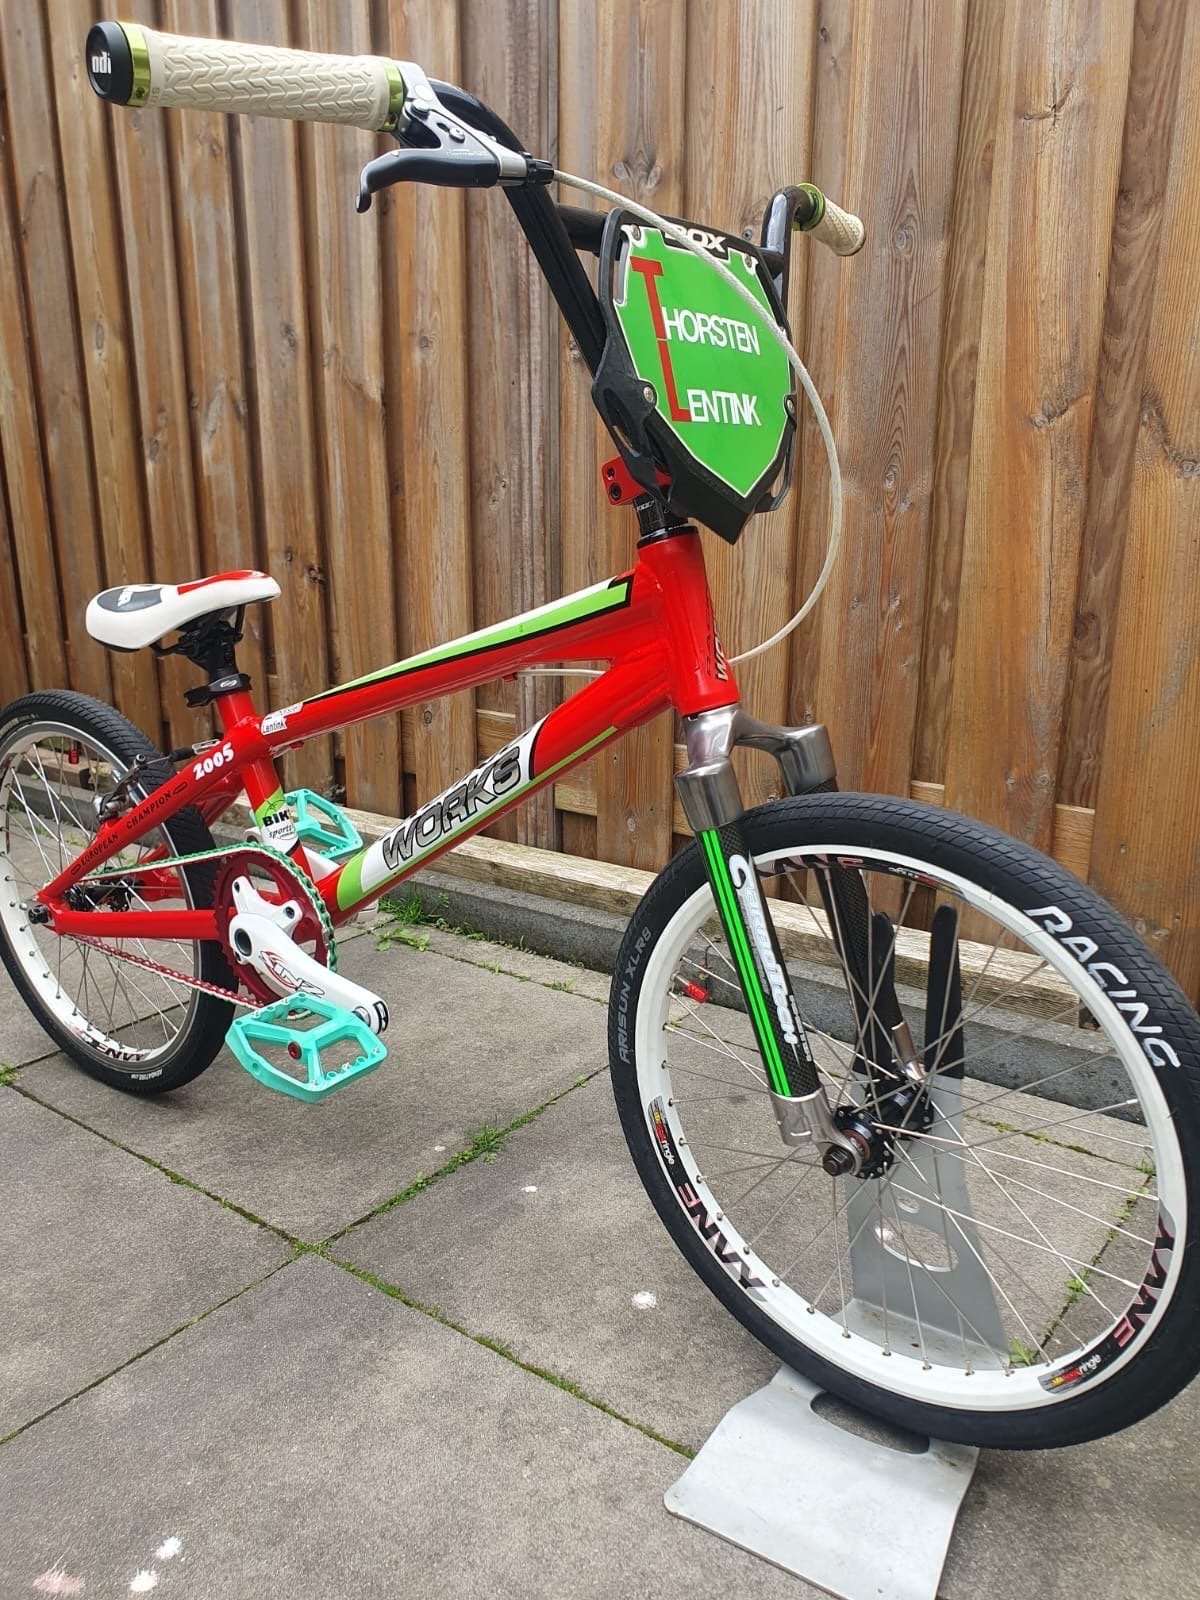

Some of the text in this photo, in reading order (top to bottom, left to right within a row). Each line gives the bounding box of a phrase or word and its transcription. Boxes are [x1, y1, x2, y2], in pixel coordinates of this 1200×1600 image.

[92, 51, 112, 74] odi
[192, 742, 235, 781] 2005
[126, 790, 172, 830] CHAMPION
[262, 808, 291, 827] BIK
[382, 746, 522, 871] WORKS
[617, 926, 652, 1065] ARISUN XLR8
[1022, 905, 1182, 1069] RACING
